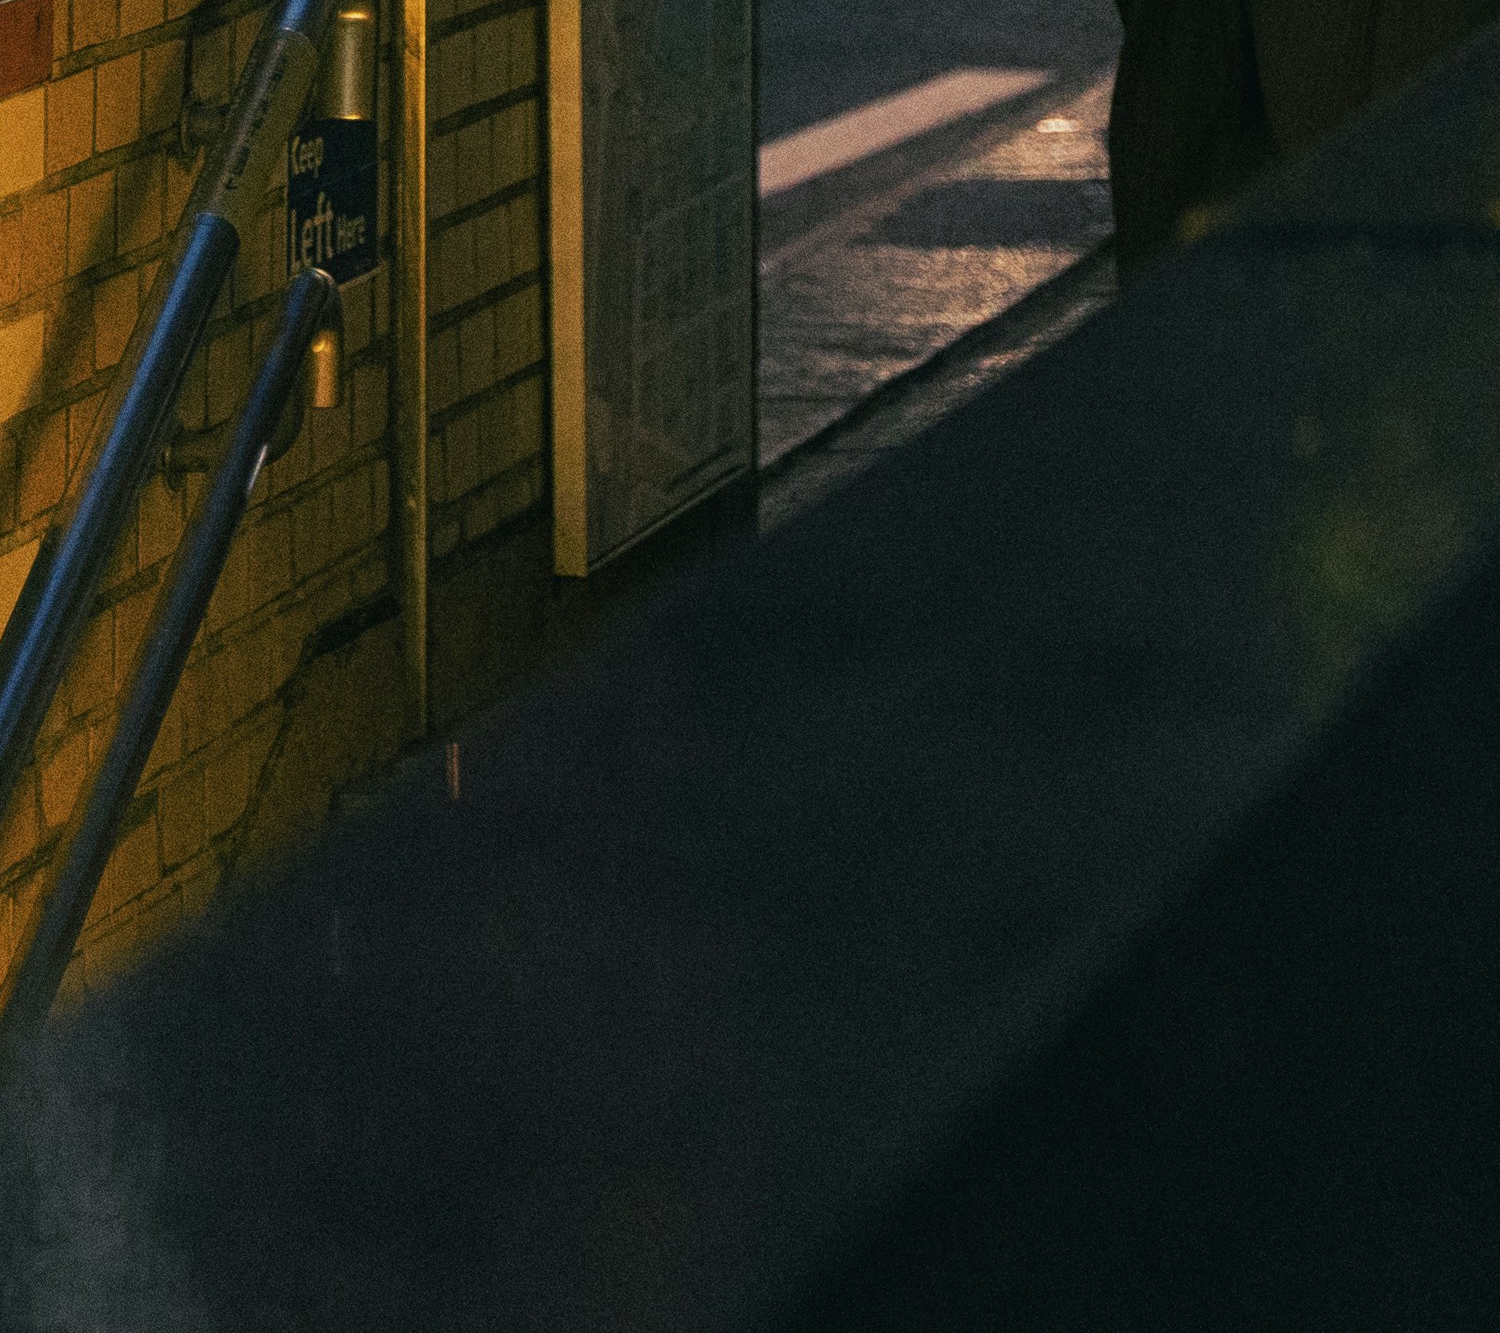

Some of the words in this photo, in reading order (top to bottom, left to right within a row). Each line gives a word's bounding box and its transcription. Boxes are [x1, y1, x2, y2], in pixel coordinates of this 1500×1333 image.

[290, 135, 325, 179] Keep
[290, 191, 335, 275] Left
[336, 213, 367, 254] Here
